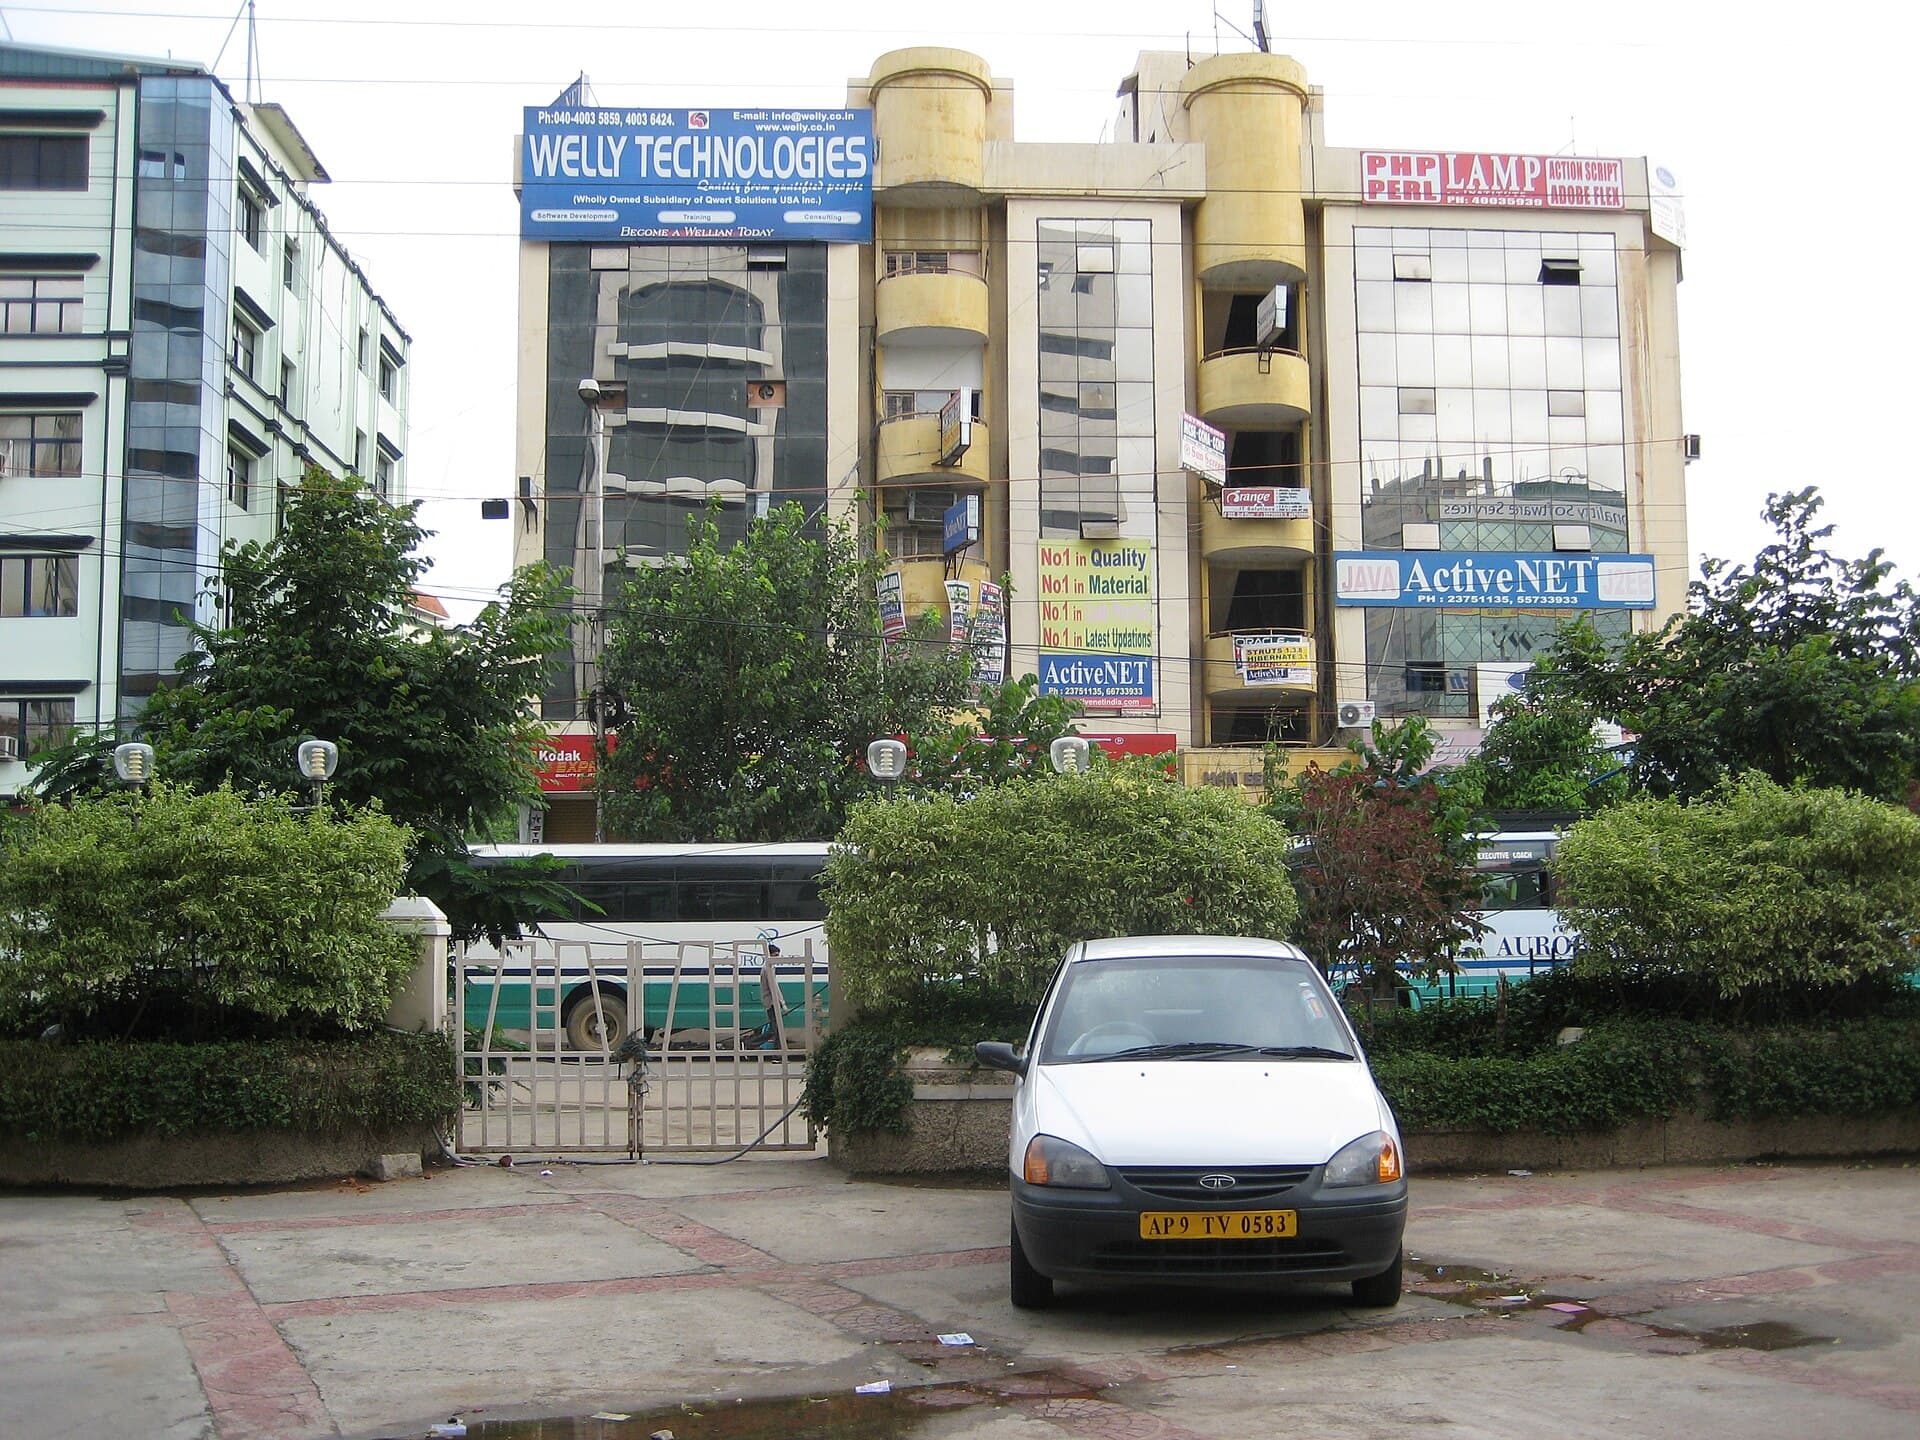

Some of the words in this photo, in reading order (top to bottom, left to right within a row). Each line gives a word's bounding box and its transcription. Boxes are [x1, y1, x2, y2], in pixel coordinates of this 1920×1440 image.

[538, 111, 596, 125] Ph:040-4003
[598, 112, 623, 127] 5859,
[625, 113, 647, 125] 4003
[650, 113, 675, 126] 6424.
[733, 112, 768, 121] E-mail:
[772, 111, 854, 122] info@welly.co.in
[755, 123, 835, 133] www.welly.co.in
[529, 134, 628, 178] WELLY
[635, 135, 867, 179] TECHNOLOGIES
[1367, 155, 1436, 177] PHP
[1445, 154, 1541, 191] LAMP
[1549, 160, 1583, 181] ACTION
[1585, 161, 1618, 182] SCRIPT
[573, 195, 607, 206] (Wholly
[610, 195, 641, 204] Owned
[643, 195, 692, 205] Subsidiary
[694, 196, 703, 204] of
[734, 196, 777, 205] Solutions
[780, 196, 799, 205] USA
[801, 196, 822, 206] Inc.)
[1368, 180, 1437, 201] PERL
[1551, 184, 1591, 205] ADOBE
[1593, 185, 1620, 206] FLEX
[537, 212, 567, 220] Software
[570, 212, 615, 221] Development
[683, 214, 711, 222] Training
[1075, 552, 1087, 567] in
[1090, 547, 1147, 572] Quality
[1074, 579, 1085, 594] in
[1089, 574, 1149, 595] Material
[1341, 565, 1396, 592] JAVA
[1403, 558, 1593, 593] ActiveNET
[1447, 595, 1513, 605] 23751135,
[1517, 596, 1578, 604] 55733933
[1073, 605, 1083, 621] in
[1073, 632, 1083, 647] in
[1085, 627, 1110, 648] Latest
[1112, 627, 1152, 650] Updations
[1044, 660, 1149, 685] ActiveNET
[1064, 687, 1104, 697] 23751135,
[538, 750, 581, 762] Kodak
[1477, 851, 1510, 860] EXECUTIVE
[1512, 851, 1533, 859] COACH
[1497, 936, 1576, 956] AURO
[1202, 1216, 1231, 1234] TV
[1241, 1215, 1286, 1234] 0583
